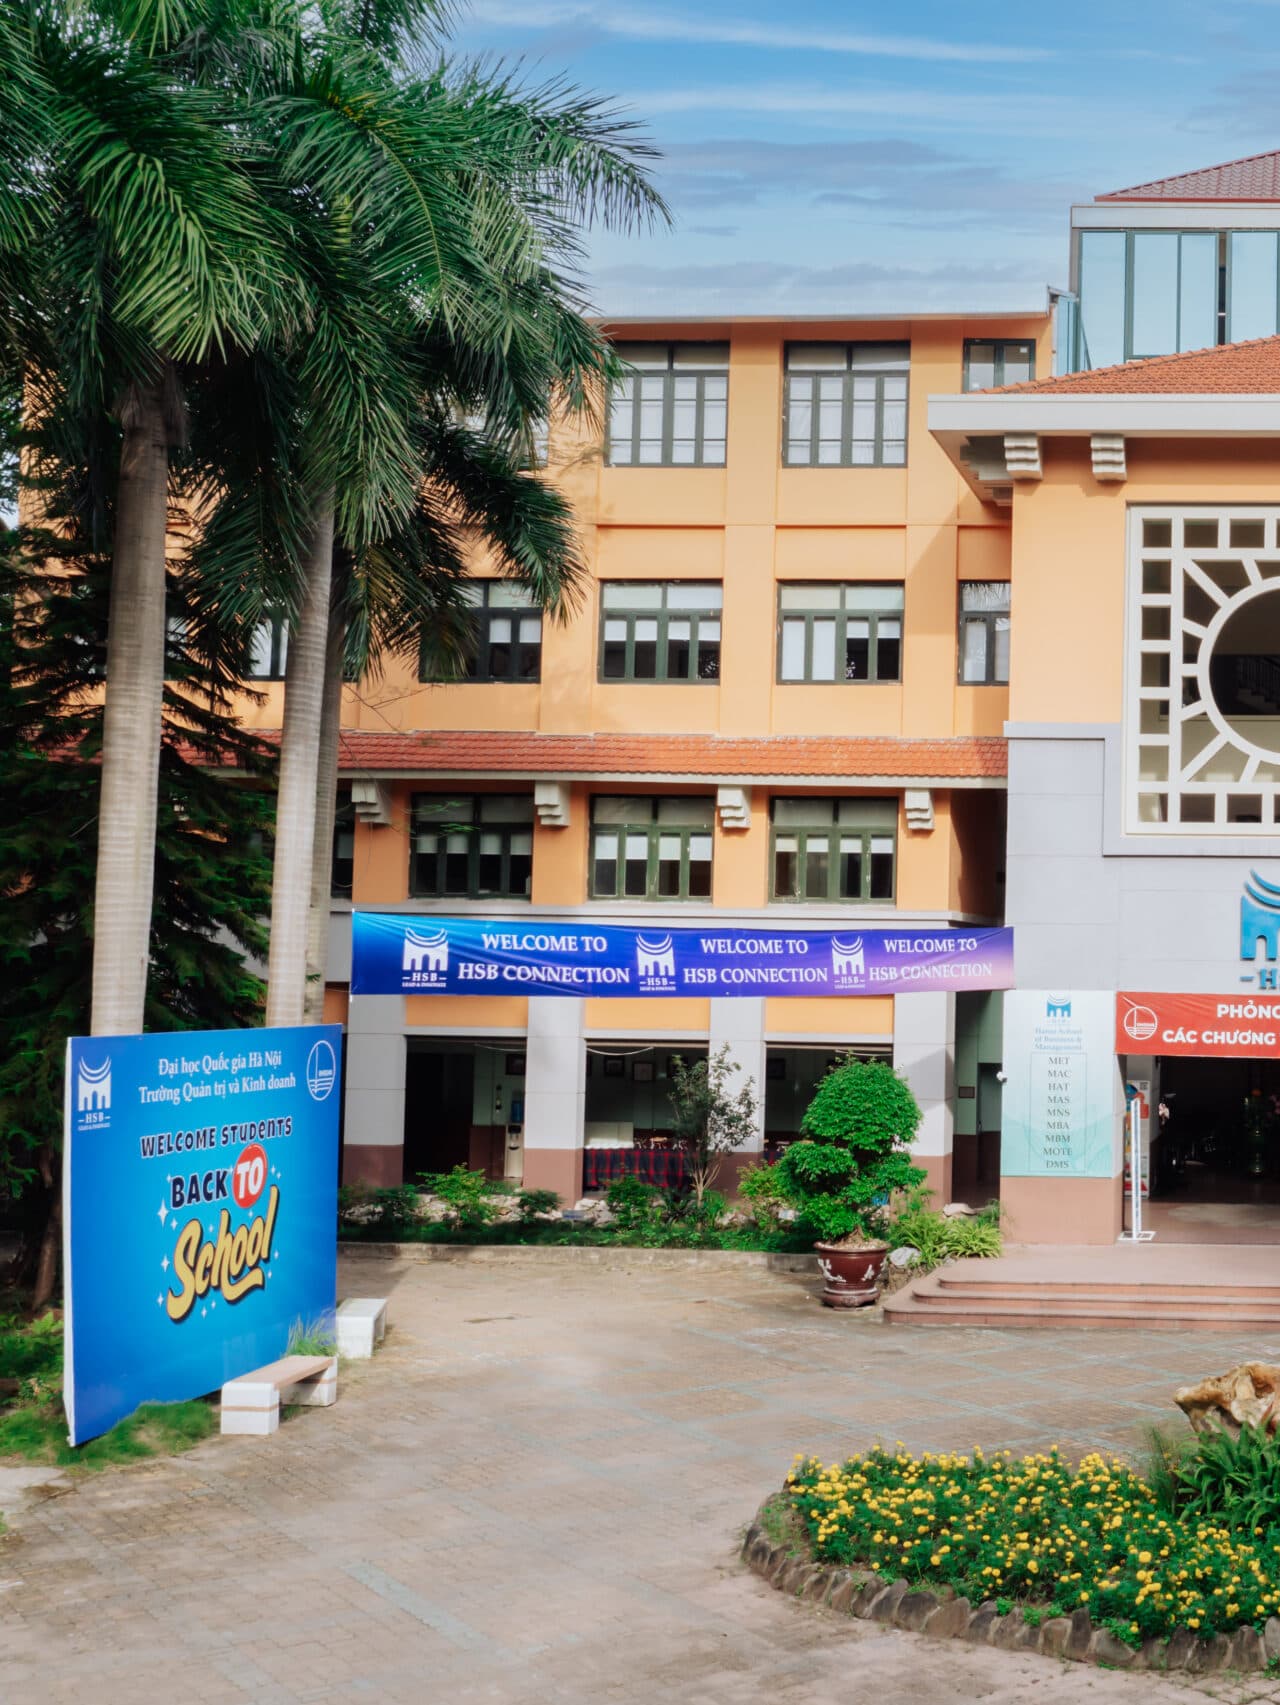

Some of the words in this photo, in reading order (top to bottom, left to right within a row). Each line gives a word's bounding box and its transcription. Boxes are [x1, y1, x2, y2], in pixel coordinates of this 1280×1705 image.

[481, 932, 578, 952] WELCOME
[580, 935, 608, 953] TO
[701, 938, 784, 954] WELCOME
[785, 939, 809, 954] TO
[884, 938, 956, 953] WELCOME
[957, 937, 978, 952] TO
[412, 972, 438, 982] HSB
[458, 962, 499, 981] HSB
[502, 964, 631, 985] CONNECTION
[683, 968, 717, 983] HSB
[720, 968, 828, 983] CONNECTION
[869, 967, 898, 981] HSB
[901, 963, 993, 980] CONNECTION
[647, 977, 668, 986] HSB
[1162, 1026, 1198, 1044] CÁC
[1201, 1029, 1276, 1046] CHƯƠNG
[158, 1057, 179, 1079] Đại
[181, 1056, 200, 1077] học
[202, 1051, 230, 1075] Quốc
[231, 1053, 247, 1074] gia
[248, 1051, 263, 1068] Hà
[264, 1050, 282, 1070] Nội
[1048, 1057, 1071, 1065] MET
[1047, 1070, 1071, 1078] MAC
[138, 1085, 181, 1105] Trường
[183, 1080, 212, 1101] Quản
[214, 1080, 226, 1099] trị
[228, 1078, 240, 1094] và
[242, 1075, 266, 1092] Kinh
[268, 1072, 296, 1090] doanh
[1048, 1083, 1071, 1091] HAT
[1047, 1096, 1070, 1104] MAS
[1047, 1108, 1071, 1117] MNS
[1047, 1121, 1070, 1130] MBA
[140, 1127, 216, 1159] WELCOME
[1045, 1134, 1071, 1143] MBM
[1043, 1147, 1073, 1156] MOTE
[1046, 1160, 1070, 1169] DMS
[170, 1168, 229, 1210] BACK
[237, 1157, 264, 1199] TO
[166, 1184, 279, 1323] School
